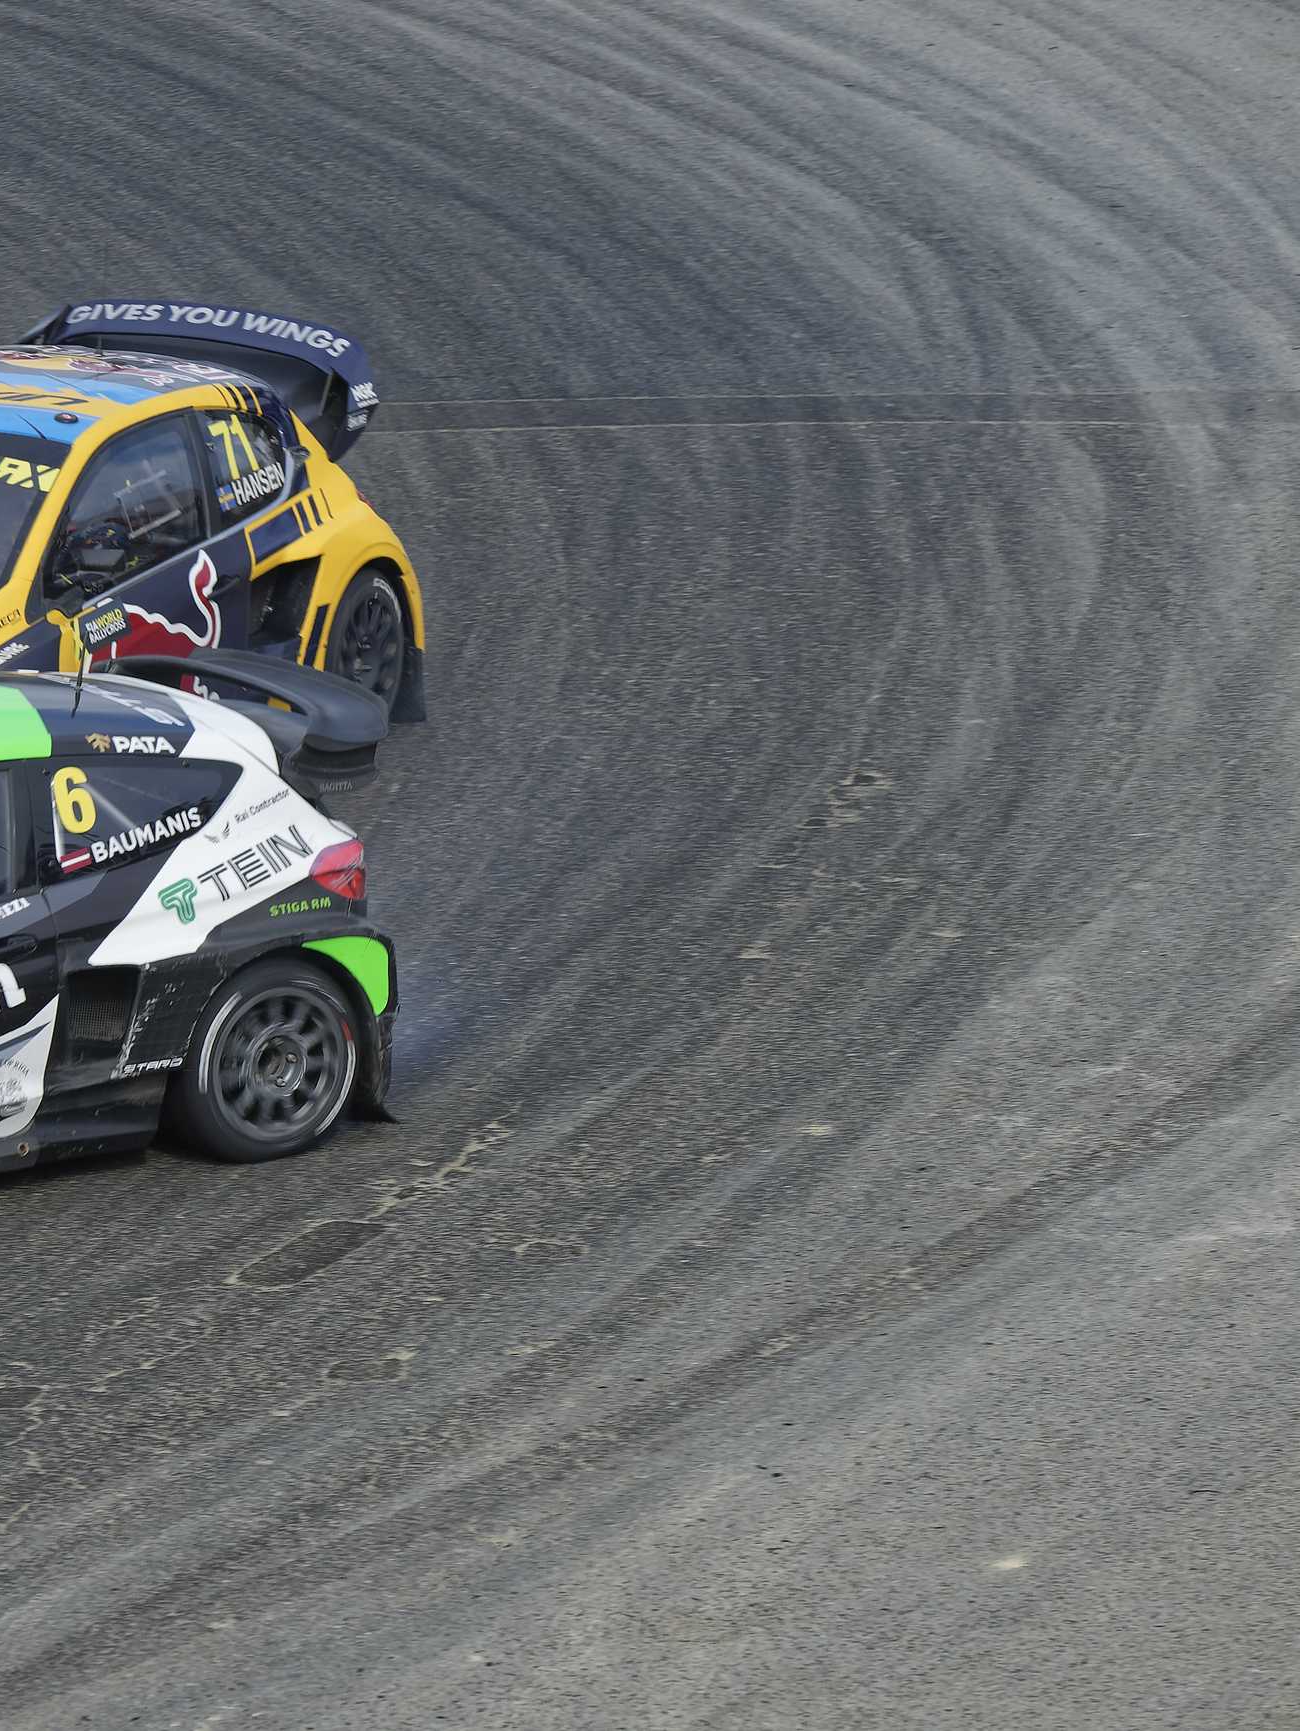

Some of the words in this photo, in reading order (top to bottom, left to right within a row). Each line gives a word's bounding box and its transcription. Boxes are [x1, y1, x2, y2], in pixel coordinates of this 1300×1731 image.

[66, 304, 164, 324] GIVES
[168, 305, 243, 328] YOU
[243, 312, 352, 358] WINGS
[207, 414, 261, 482] 71
[230, 462, 286, 507] HANSEN
[112, 735, 177, 755] PATA
[53, 766, 97, 835] 6
[89, 806, 203, 864] BAUMANIS
[197, 824, 315, 902] TEIN
[269, 900, 309, 917] STIGA
[124, 1056, 184, 1074] STARD
